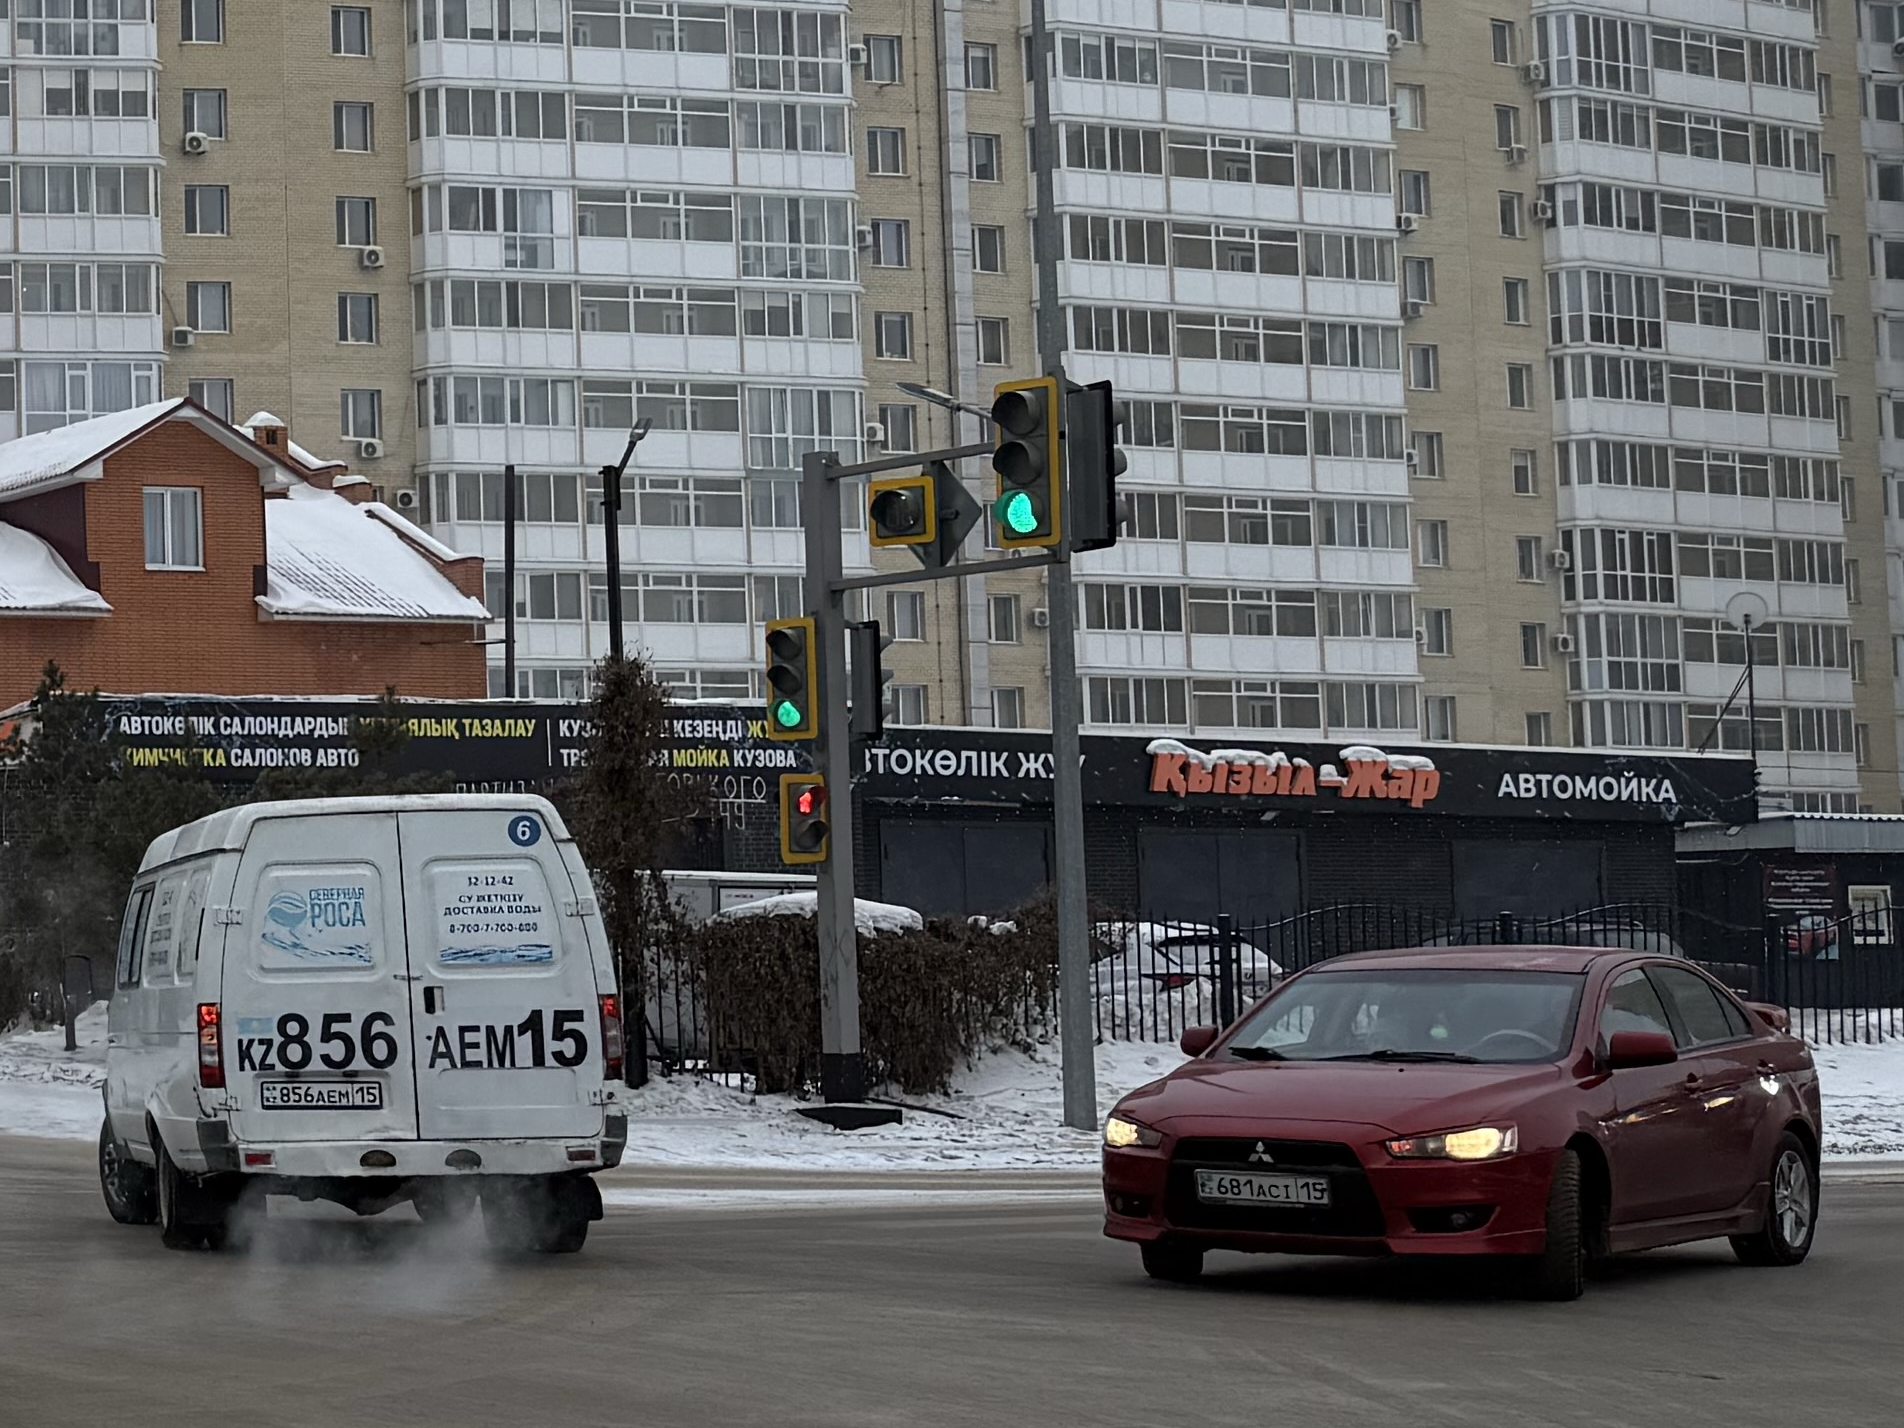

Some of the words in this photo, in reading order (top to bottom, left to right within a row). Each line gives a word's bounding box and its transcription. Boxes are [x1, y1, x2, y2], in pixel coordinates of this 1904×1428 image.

[219, 716, 349, 739] САЛОНДАРДЫ
[462, 718, 536, 738] ТАЗАЛАУ
[672, 719, 743, 741] КЕЗЕҢДІ
[230, 748, 312, 767] САЛОНОВ
[315, 748, 360, 767] АВТО
[672, 744, 730, 767] МОЙКА
[733, 749, 797, 767] КУЗОВА
[1497, 771, 1677, 804] АВТОМОЙКА
[516, 821, 531, 841] 6
[310, 901, 366, 928] РОСА
[279, 1085, 351, 1105] 856AEM
[355, 1085, 378, 1104] 15
[1299, 1180, 1328, 1201] 15
